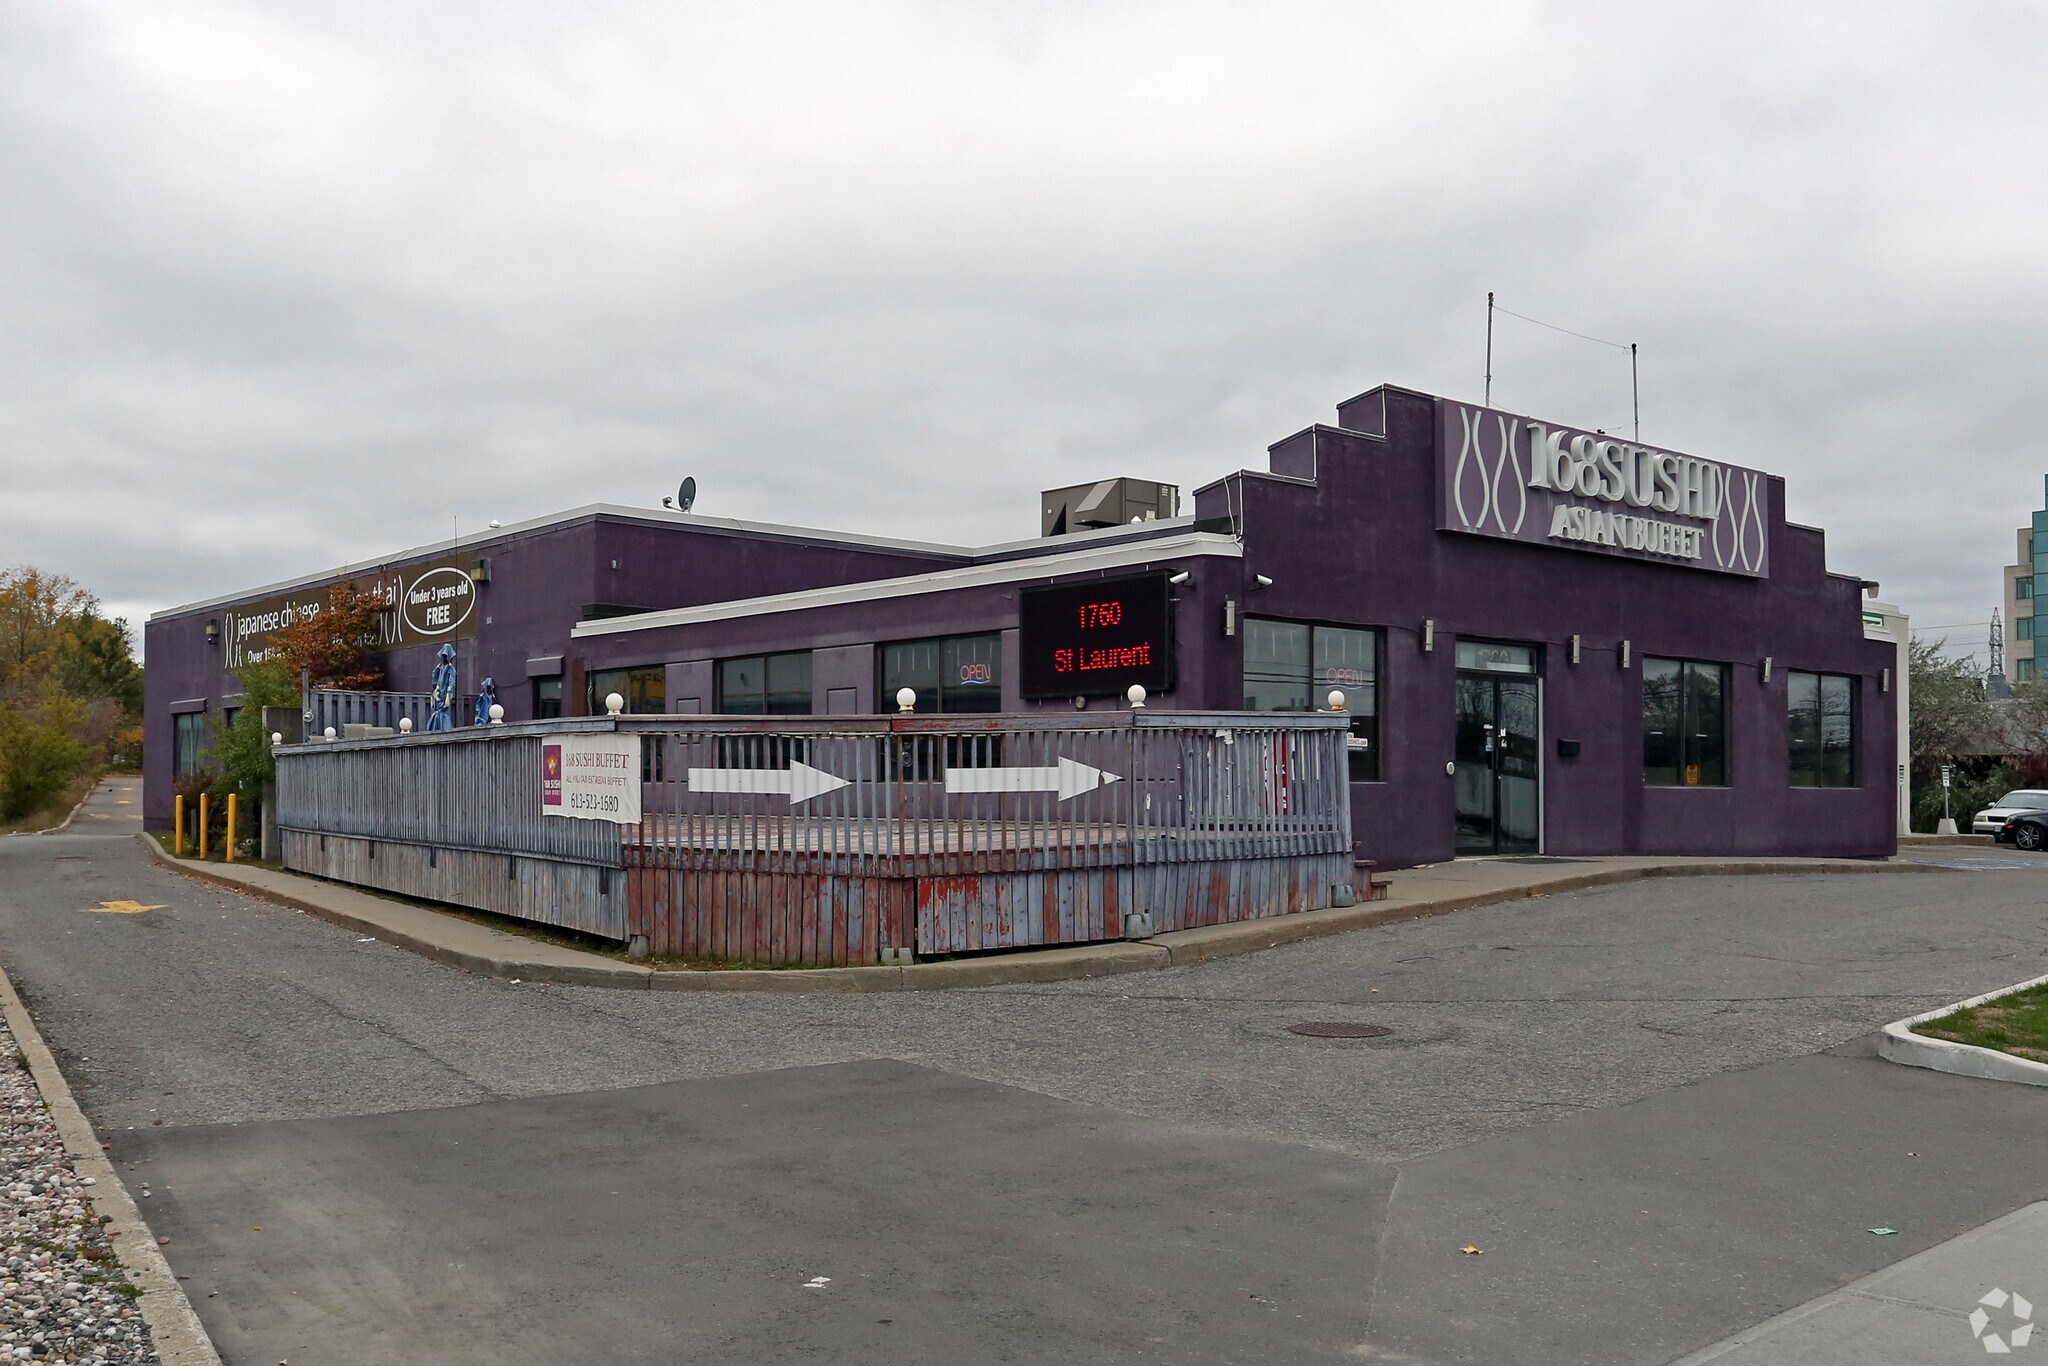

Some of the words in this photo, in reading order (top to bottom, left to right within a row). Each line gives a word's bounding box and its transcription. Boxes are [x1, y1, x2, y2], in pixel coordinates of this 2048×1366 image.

[1548, 504, 1628, 548] ASIAN
[1625, 516, 1705, 560] BUFFET
[410, 588, 431, 605] Under
[431, 586, 436, 601] 3
[436, 585, 456, 604] years
[456, 580, 468, 596] old
[426, 604, 450, 627] FREE
[1079, 601, 1121, 629] 1760
[236, 612, 279, 642] japanese
[247, 650, 263, 664] Over
[1055, 649, 1073, 672] St
[1080, 641, 1150, 671] Laurent
[960, 664, 991, 680] OPEN
[1326, 667, 1362, 685] OPEN
[575, 752, 595, 767] SUSHI
[596, 752, 629, 769] BUFFET
[607, 777, 627, 787] BUFFET
